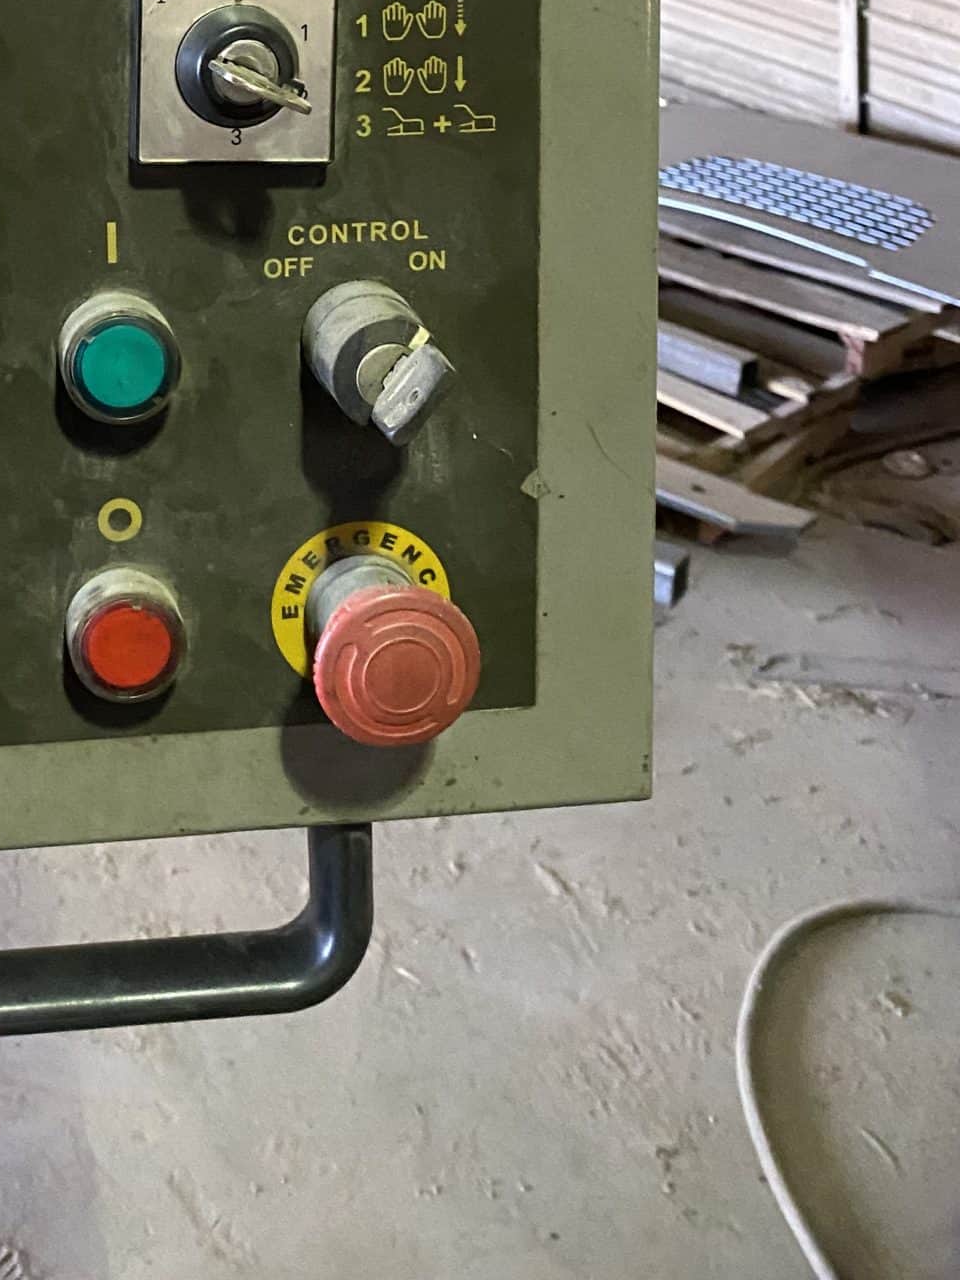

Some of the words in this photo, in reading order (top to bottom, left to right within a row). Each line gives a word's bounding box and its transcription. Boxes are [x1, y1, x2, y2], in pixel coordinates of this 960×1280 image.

[300, 24, 309, 42] 1
[355, 15, 368, 37] 1
[355, 70, 372, 93] 2
[231, 128, 243, 146] 3
[355, 114, 373, 138] 3
[287, 220, 429, 246] CONTROL
[263, 257, 315, 279] OFF
[408, 250, 447, 273] ON
[281, 529, 437, 620] EMERGENC
